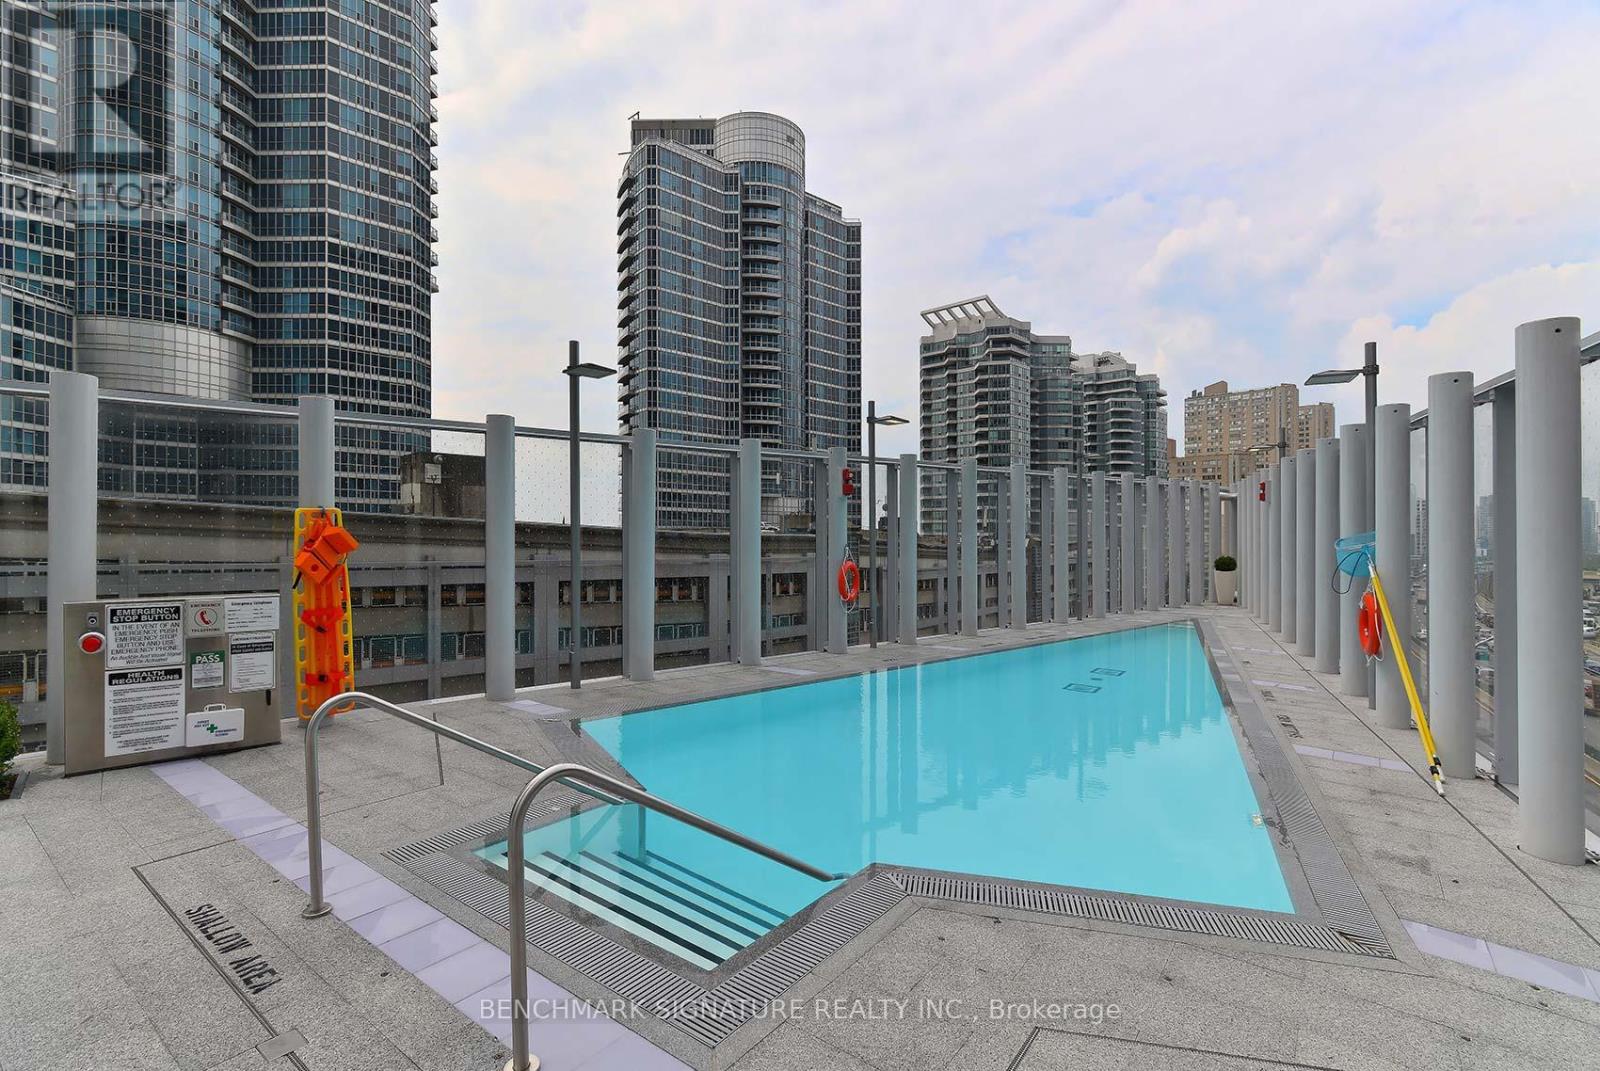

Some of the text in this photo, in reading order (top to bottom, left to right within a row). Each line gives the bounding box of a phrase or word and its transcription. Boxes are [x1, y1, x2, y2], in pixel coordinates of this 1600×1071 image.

[116, 608, 176, 616] EMERGENCY
[196, 654, 220, 664] PASS
[128, 670, 165, 678] HEALTH
[112, 674, 180, 686] REGULATIONS
[184, 903, 282, 995] SHALLOW AREA
